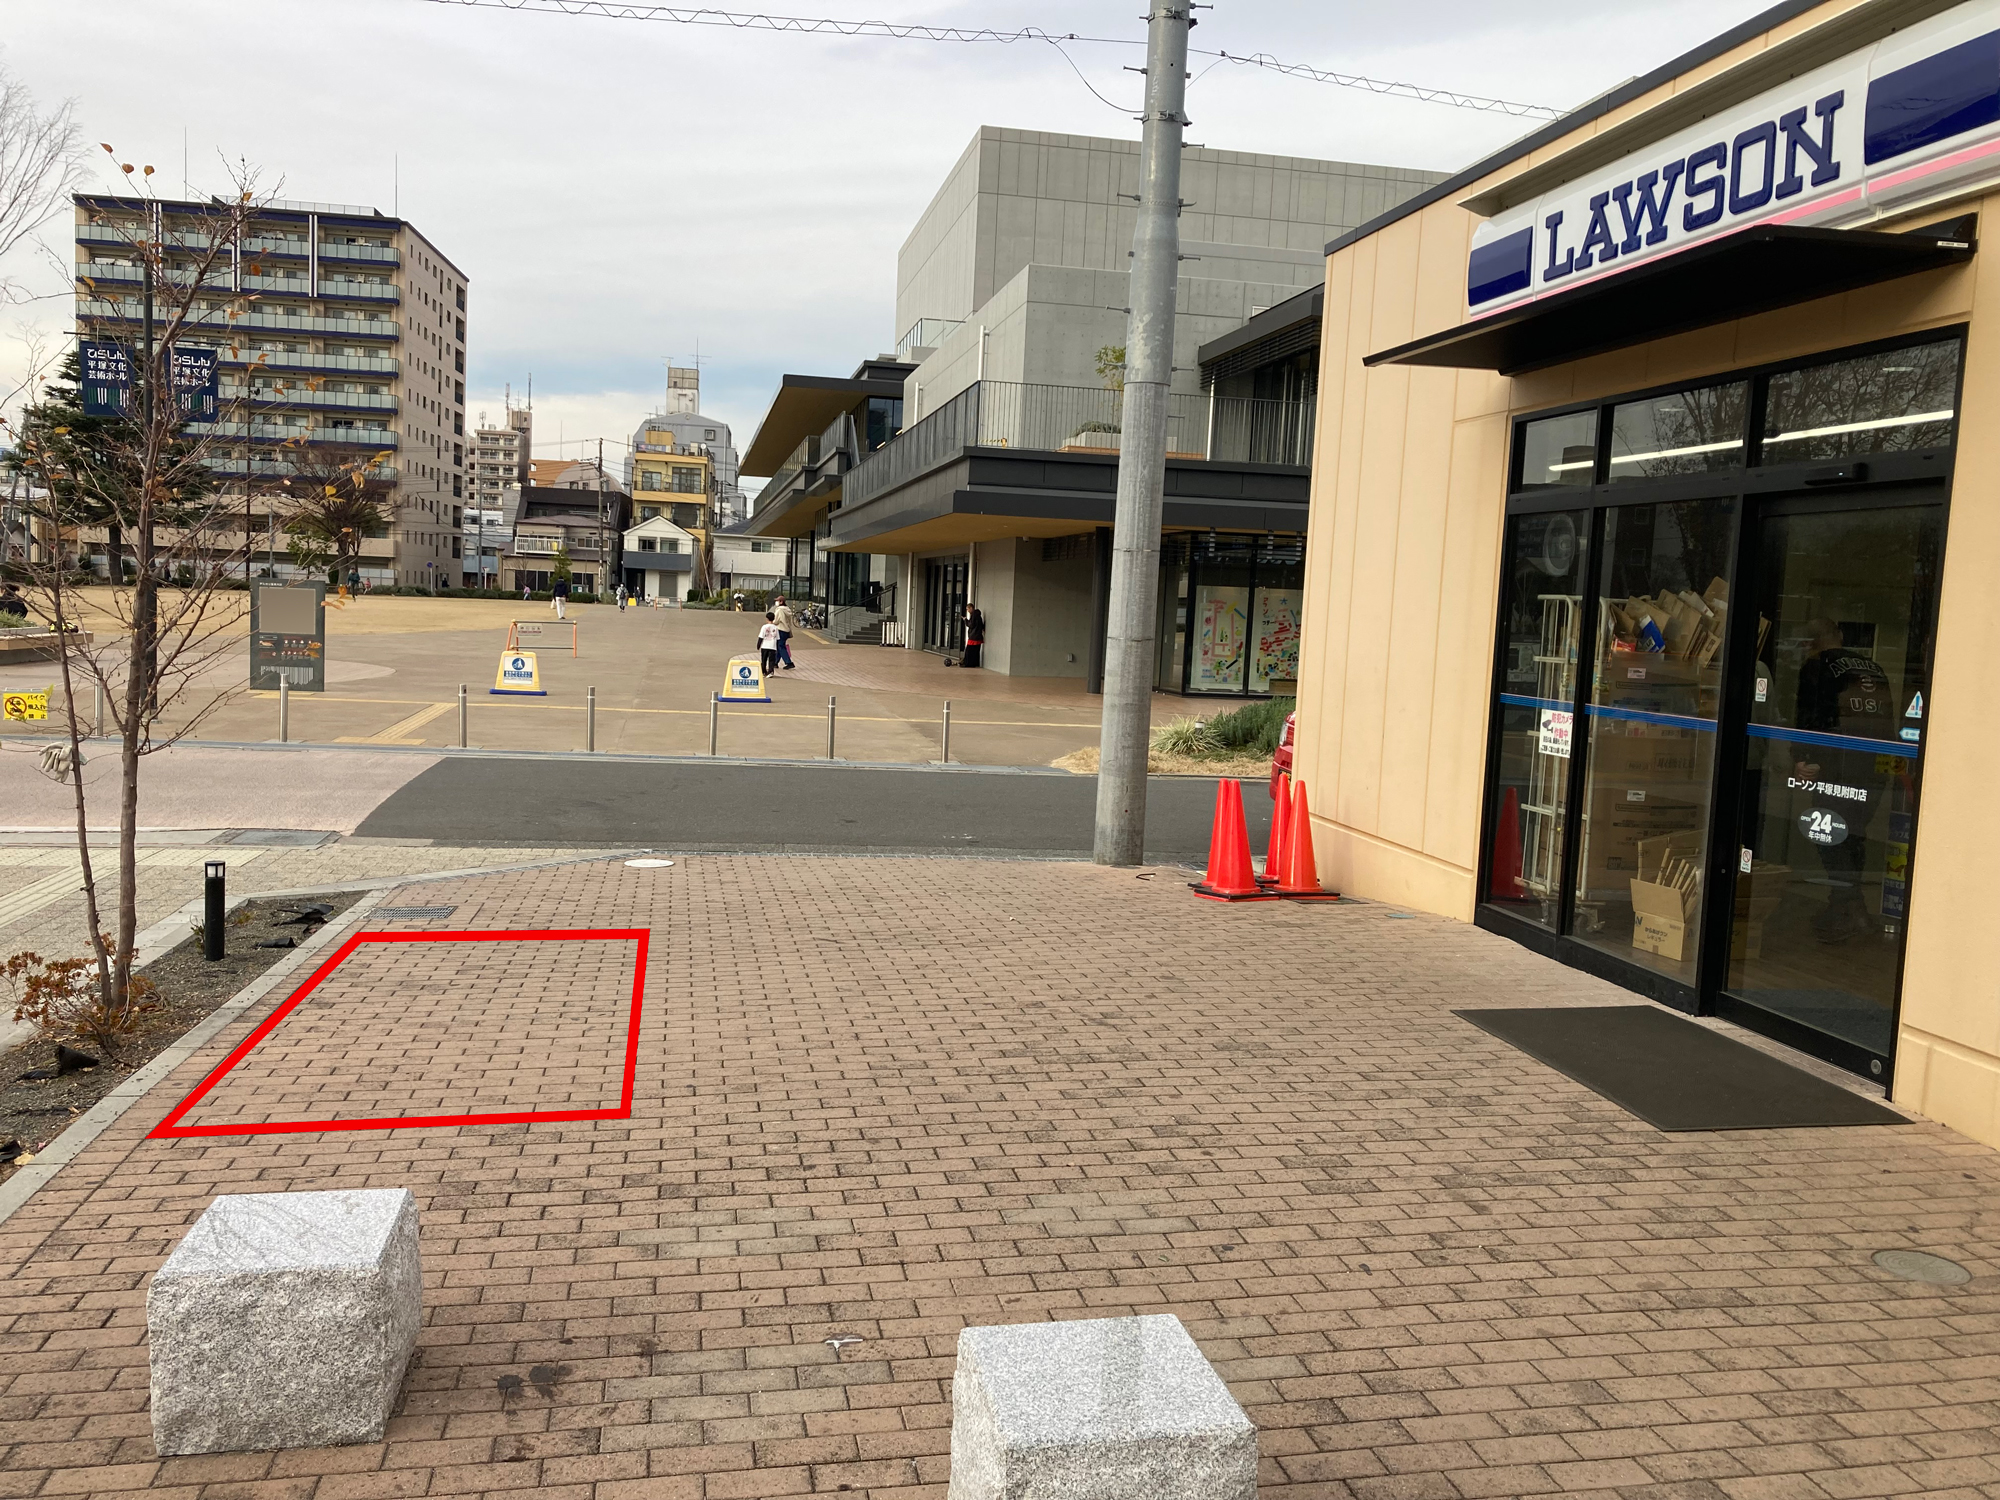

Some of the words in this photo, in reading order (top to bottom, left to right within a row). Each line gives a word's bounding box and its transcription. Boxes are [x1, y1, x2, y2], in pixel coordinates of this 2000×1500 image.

[1543, 90, 1844, 282] LAWSON
[86, 348, 126, 360] ひらしん
[87, 360, 127, 371] 平塚文化
[88, 370, 128, 380] 芸術ホール
[1551, 712, 1574, 724] 防犯カメラ
[1554, 728, 1569, 739] 作動中
[1787, 777, 1868, 802] ローソン平塚見附町店
[1810, 811, 1832, 834] 24
[1831, 822, 1846, 830] HOURS
[1808, 831, 1833, 844] 年中無休
